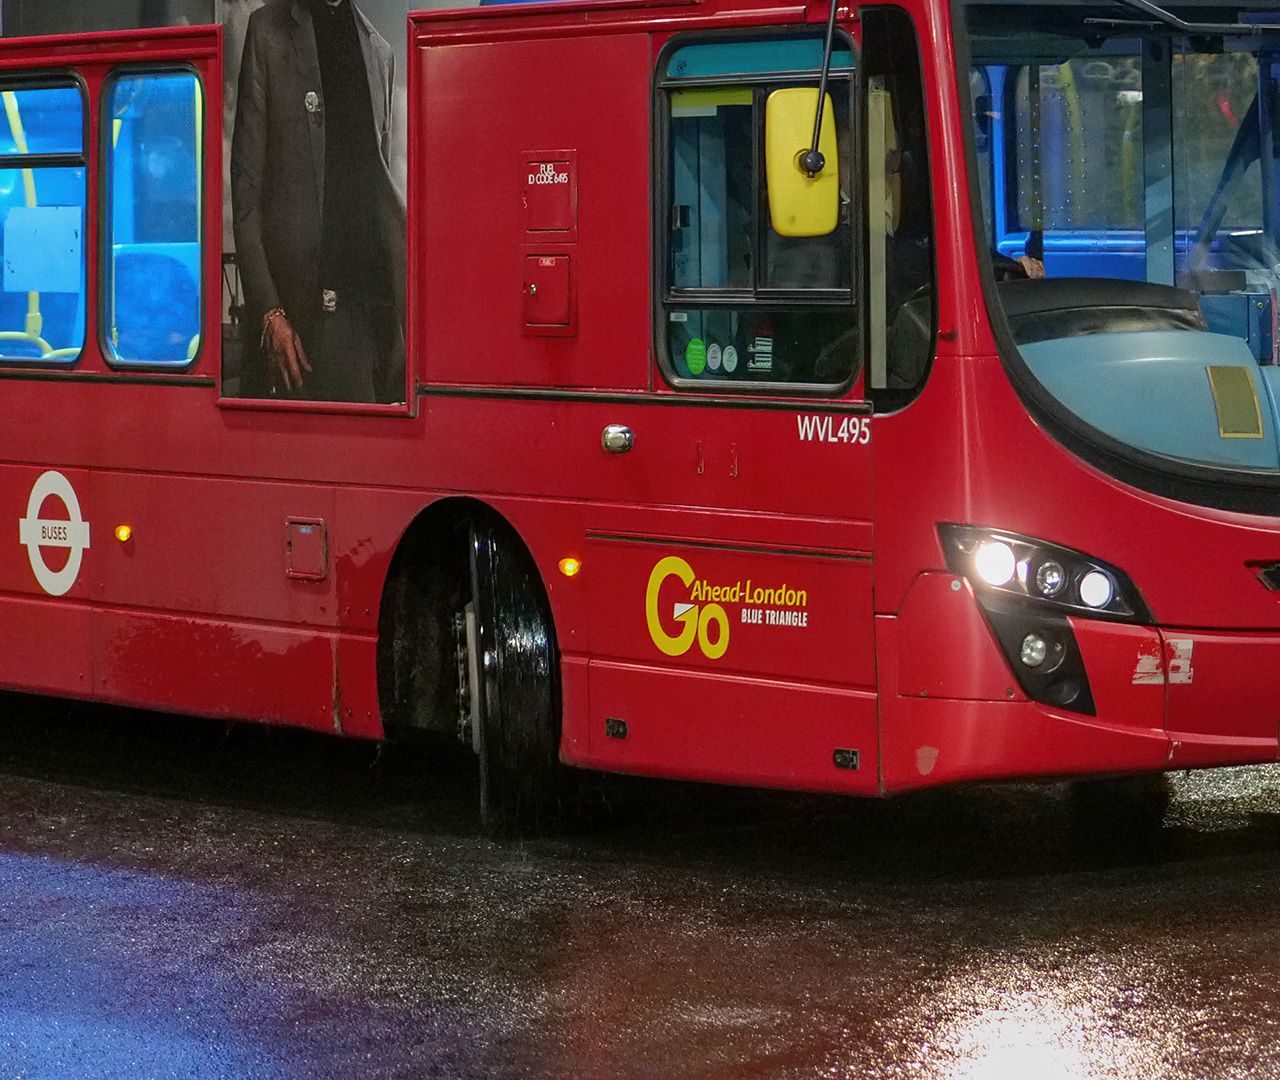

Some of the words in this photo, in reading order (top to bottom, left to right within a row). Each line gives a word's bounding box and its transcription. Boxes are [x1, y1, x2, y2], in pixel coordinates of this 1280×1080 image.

[797, 415, 870, 444] WVL495
[41, 525, 67, 540] BUSES
[645, 556, 730, 659] Go
[741, 608, 763, 624] BLUE
[765, 610, 808, 627] TRIANGLE
